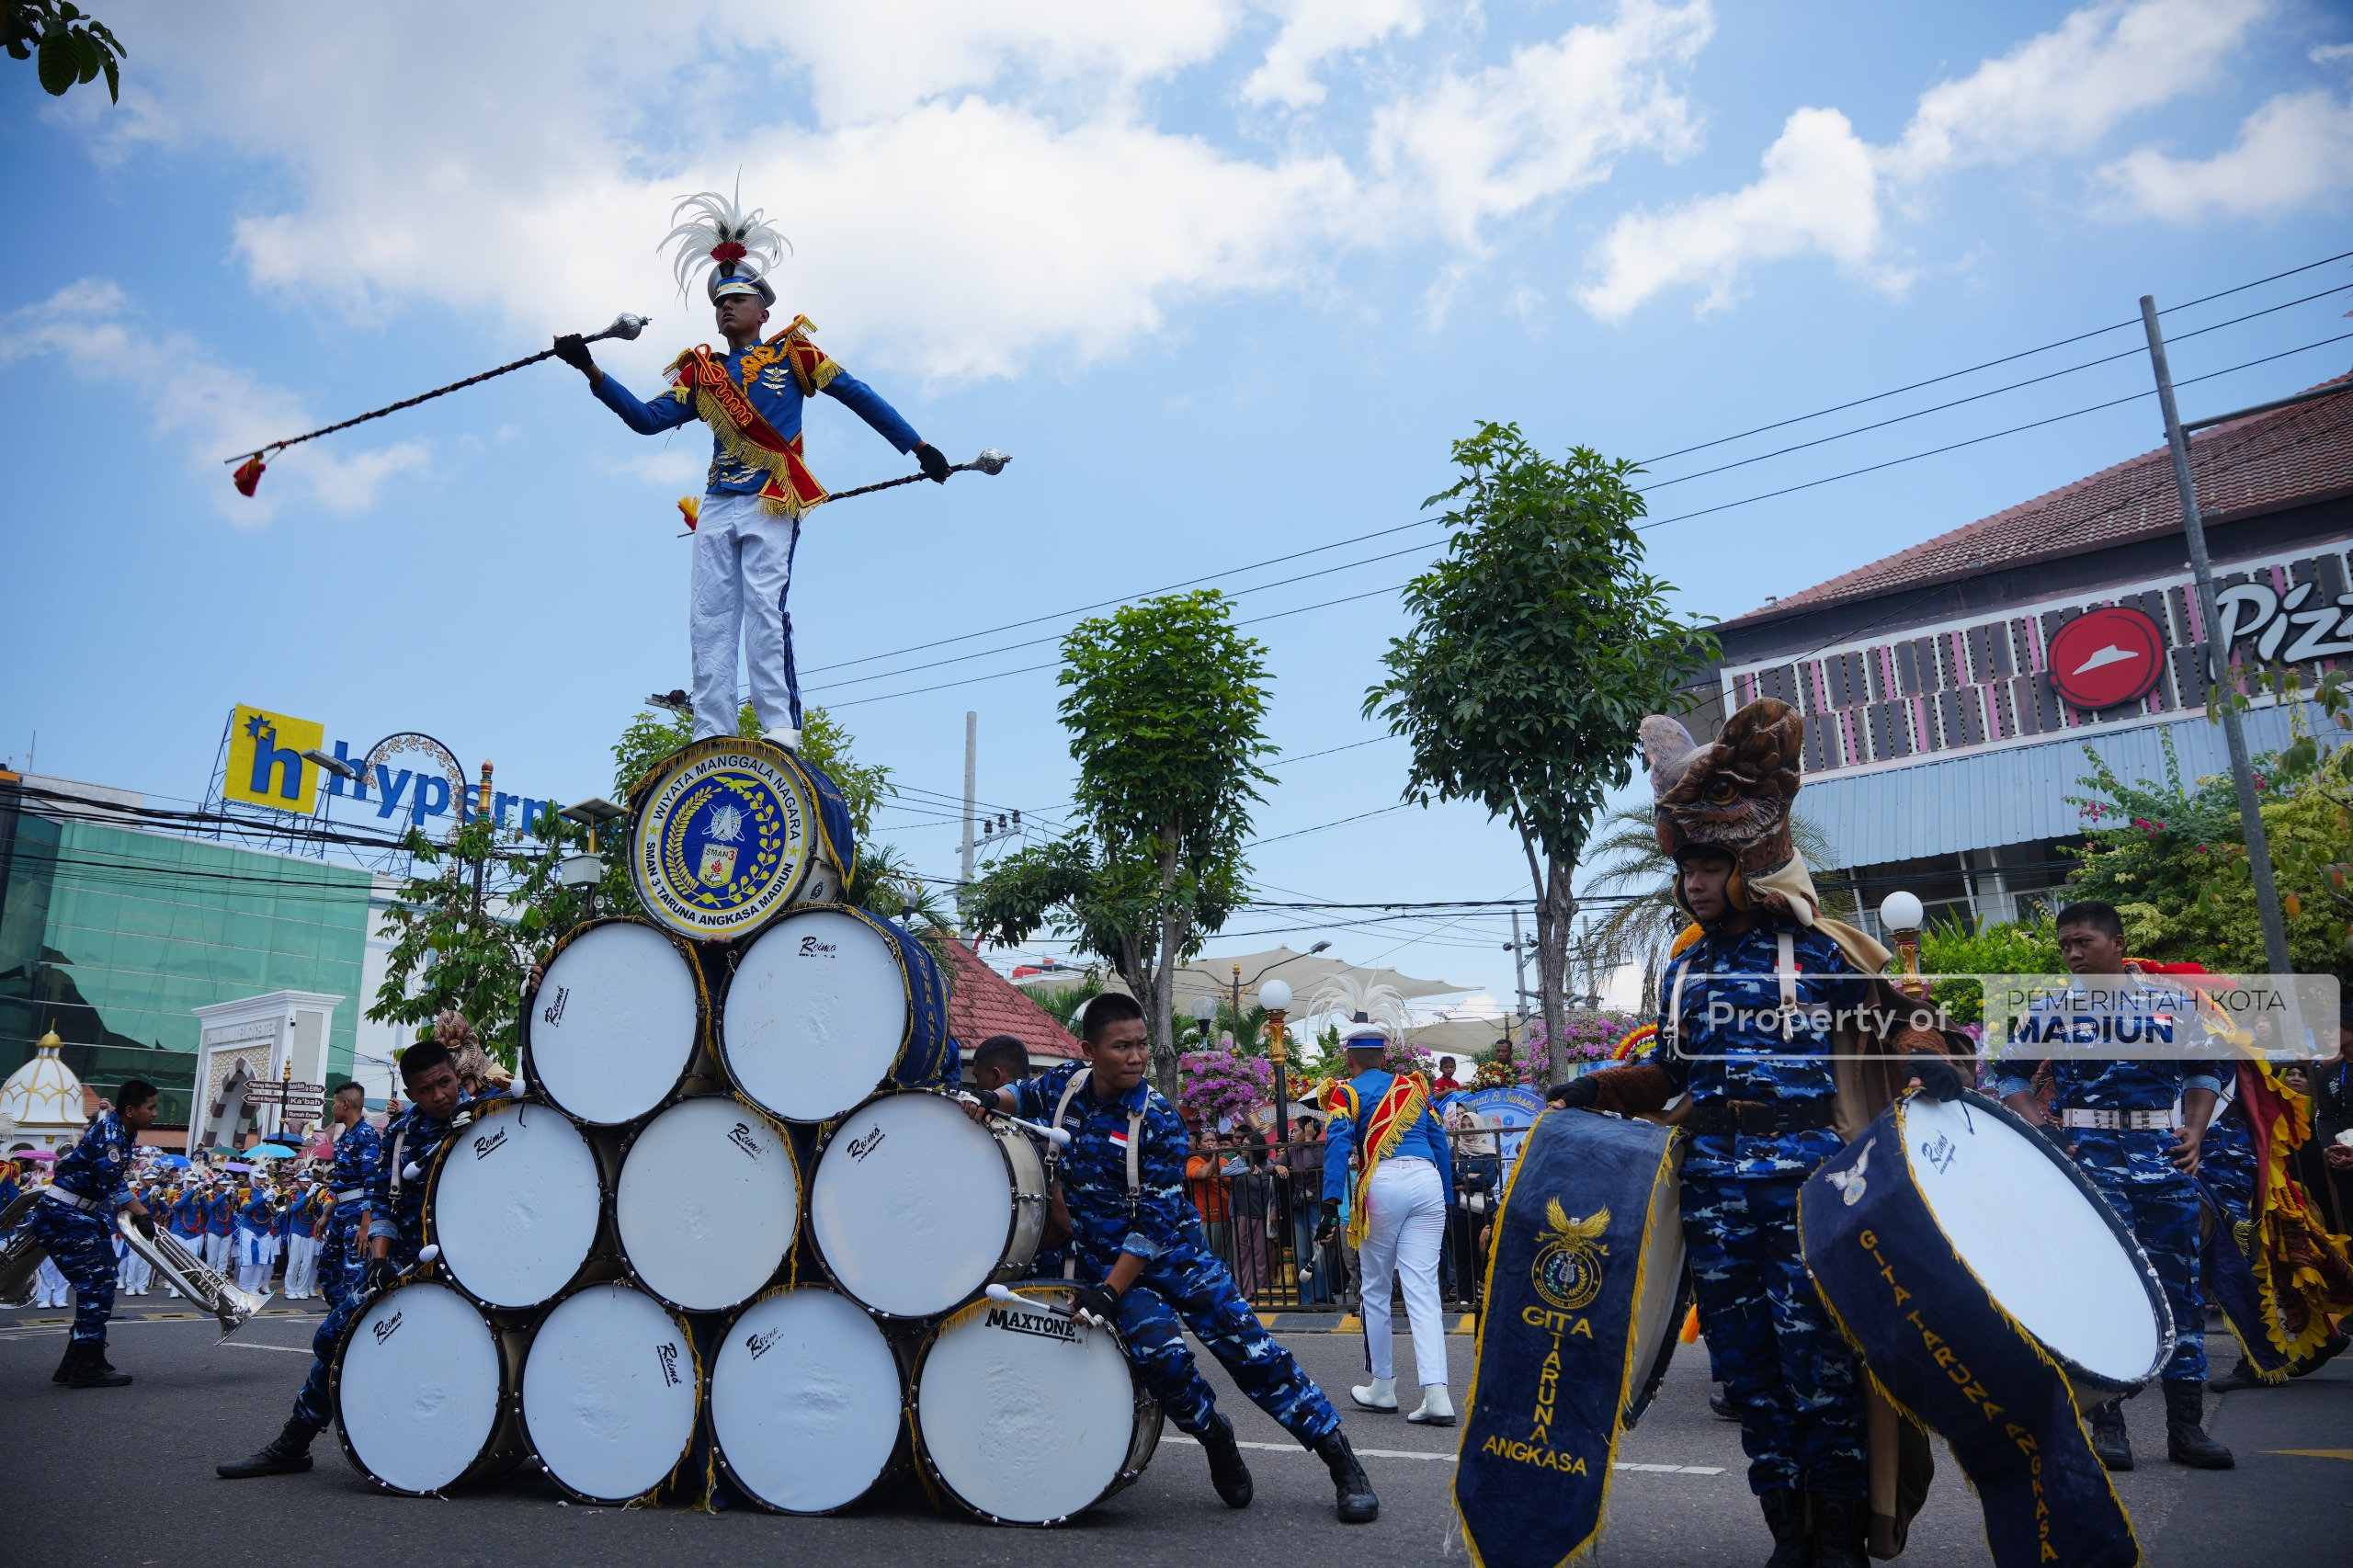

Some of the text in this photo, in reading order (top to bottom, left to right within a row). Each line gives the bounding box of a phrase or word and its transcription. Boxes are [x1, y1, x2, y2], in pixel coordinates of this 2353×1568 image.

[654, 773, 694, 820] WIYATA
[695, 756, 776, 781] MANGGALA
[773, 778, 801, 841] NAGARA
[705, 847, 735, 861] SMAN 3
[645, 842, 657, 878] SMAN
[651, 878, 661, 887] 3
[656, 886, 696, 922] TARUNA
[699, 905, 761, 926] ANGKASA
[758, 862, 795, 908] MADIUN
[544, 987, 564, 1027] Reimo
[1258, 1104, 1297, 1122] SELAT
[1503, 1091, 1537, 1111] Sukses
[474, 1130, 506, 1157] Reimo
[847, 1127, 881, 1158] Reimo
[373, 1311, 403, 1342] Reimo
[984, 1307, 1076, 1336] MAXTONE
[1521, 1306, 1594, 1340] GITA
[660, 1343, 679, 1384] Reimo
[1529, 1332, 1565, 1445] TARUNA
[1859, 1229, 2059, 1563] GITA TARUNA ANGKASA
[1482, 1435, 1588, 1477] ANGKASA
